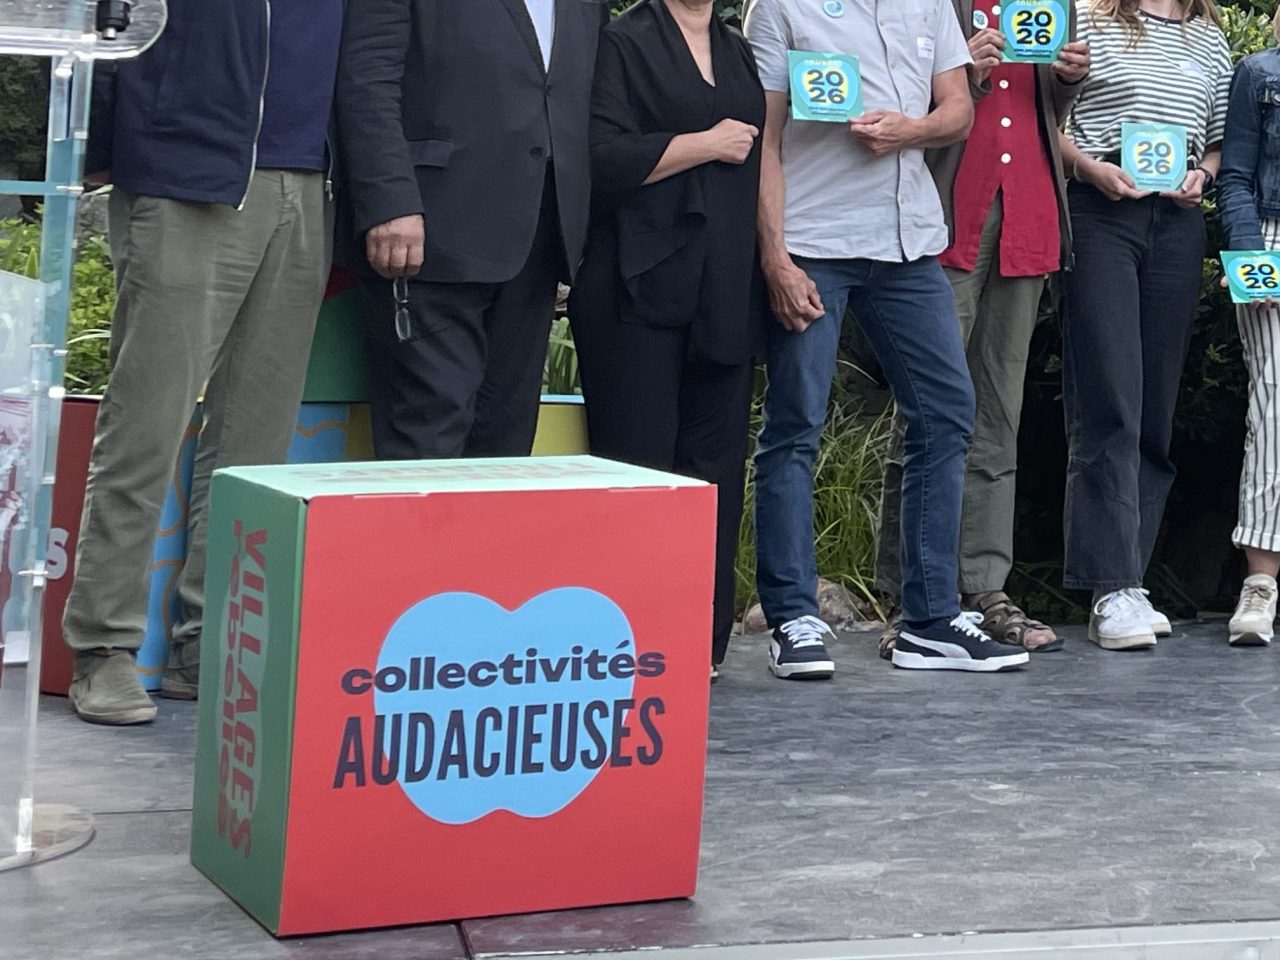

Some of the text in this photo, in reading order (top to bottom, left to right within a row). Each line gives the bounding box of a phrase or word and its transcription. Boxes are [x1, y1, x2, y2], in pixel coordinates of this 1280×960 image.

[1016, 10, 1053, 27] 20
[1016, 28, 1052, 46] 26
[807, 69, 844, 87] 20
[808, 87, 846, 105] 26
[1137, 141, 1172, 158] 20
[1137, 158, 1171, 175] 26
[1240, 263, 1275, 276] 20
[1244, 276, 1279, 289] 26
[341, 640, 666, 695] collectivités
[230, 528, 268, 859] VILLAGES
[332, 696, 666, 789] AUDACIEUSES
